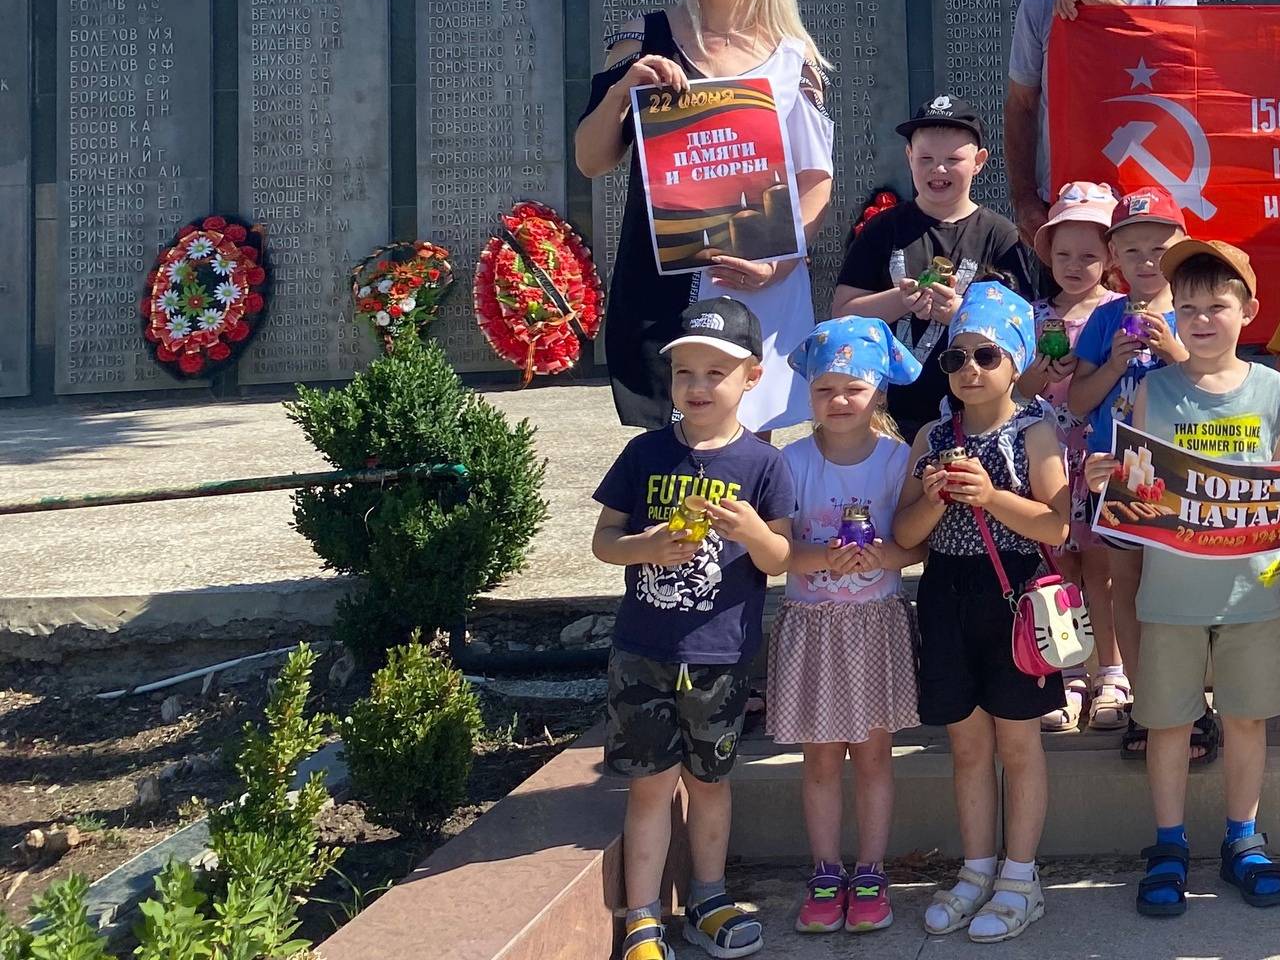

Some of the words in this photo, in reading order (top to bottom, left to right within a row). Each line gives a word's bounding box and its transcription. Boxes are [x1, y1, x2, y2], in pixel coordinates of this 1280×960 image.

[252, 6, 311, 20] ВЕЛИЧКО
[428, 0, 492, 13] ГОЛОВНЕВ
[428, 16, 492, 28] ГОЛОВНЕВ
[945, 11, 1000, 24] ЗОРЬКИН
[71, 27, 139, 42] БОЛЕЛОВ
[252, 22, 311, 35] ВЕЛИЧКО
[946, 26, 1001, 39] ЗОРЬКИН
[429, 29, 504, 43] ГОНОЧЕНКО
[71, 43, 139, 57] БОЛЕЛОВ
[429, 45, 504, 59] ГОНОЧЕНКО
[946, 41, 1001, 53] ЗОРЬКИН
[71, 59, 139, 73] БОЛЕЛОВ
[429, 60, 504, 73] ГОНОЧЕНКО
[946, 56, 1002, 68] ЗОРЬКИН
[252, 67, 302, 81] ВНУКОВ
[946, 70, 1003, 83] ЗОРЬКИН
[71, 75, 133, 88] БОРЗЫХ
[71, 90, 137, 103] БОРИСОВ
[252, 83, 302, 96] ВОЛКОВ
[252, 98, 302, 112] ВОЛКОВ
[649, 93, 672, 114] 22
[71, 106, 137, 119] БОРИСОВ
[252, 114, 302, 127] ВОЛКОВ
[71, 121, 119, 135] БОСОВ
[252, 128, 302, 142] ВОЛКОВ
[71, 137, 119, 150] БОСОВ
[687, 128, 738, 150] ДЕНЬ
[252, 144, 302, 157] ВОЛКОВ
[673, 141, 756, 167] ПАМЯТИ
[71, 152, 130, 165] БОЯРИН
[71, 167, 147, 180] БРИЧЕНКО
[665, 171, 680, 185] И
[691, 157, 769, 181] СКОРБИ
[70, 183, 145, 197] БРИЧЕНКО
[70, 198, 145, 213] БРИЧЕНКО
[252, 205, 300, 219] ГАНЕЕВ
[70, 214, 145, 228] БРИЧЕНКО
[70, 229, 145, 243] БРИЧЕНКО
[70, 244, 144, 258] БРИЧЕНКО
[70, 259, 144, 274] БРИЧЕНКО
[69, 292, 137, 305] БУРИМОВ
[70, 322, 136, 337] БУРИМОВ
[1174, 423, 1199, 435] THAT
[1201, 424, 1242, 437] SOUNDS
[1244, 425, 1261, 438] LIKE
[1186, 439, 1229, 452] SUMMER
[1233, 440, 1244, 452] TO
[646, 474, 741, 509] FUTURE
[648, 506, 682, 521] PALEO
[1175, 525, 1195, 543] 22
